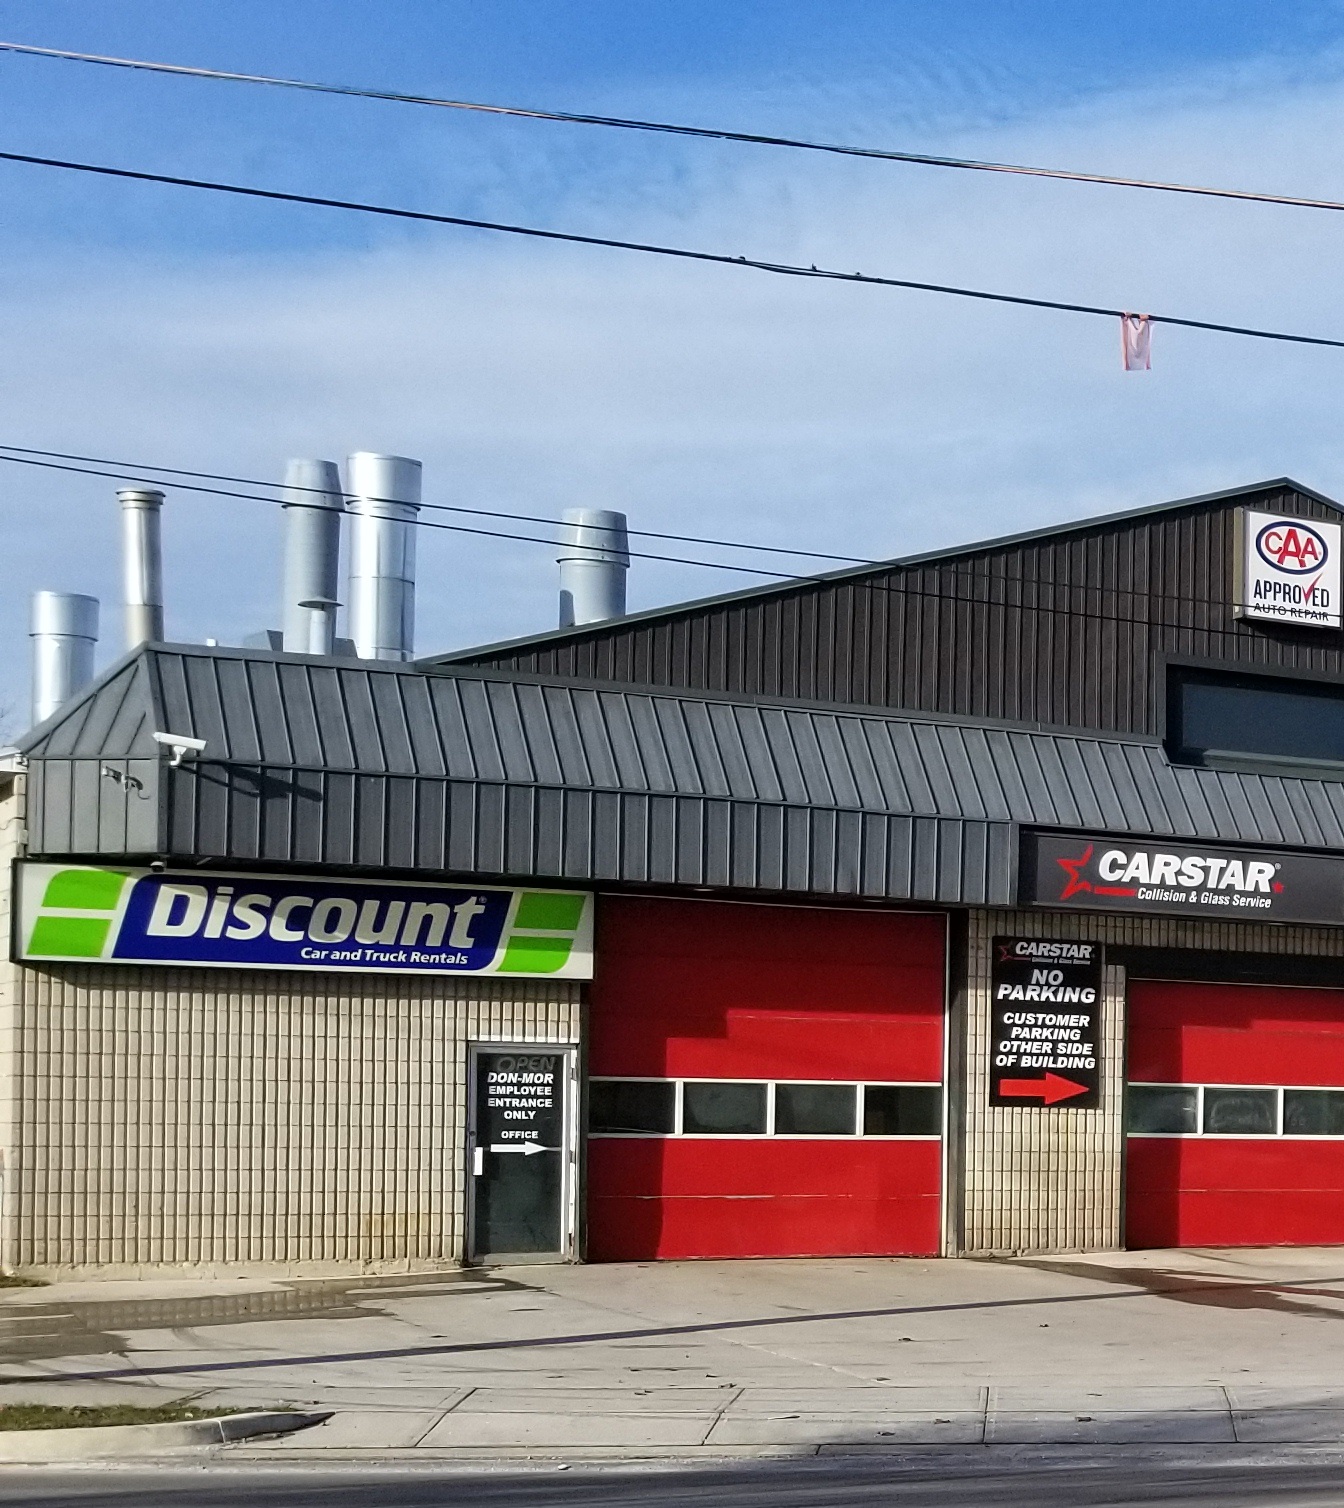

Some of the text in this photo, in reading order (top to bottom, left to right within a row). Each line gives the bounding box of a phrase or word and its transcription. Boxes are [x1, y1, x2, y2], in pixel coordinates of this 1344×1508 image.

[1264, 528, 1320, 568] CAA
[1253, 573, 1330, 608] APPROVED
[1253, 602, 1330, 622] AUTO REPAIR
[1098, 849, 1275, 893] CARSTAR
[1137, 887, 1272, 909] Collision & Glass Service
[146, 883, 485, 949] Discount
[301, 947, 468, 966] Car and Truck Rentals
[1015, 941, 1092, 959] CARSTAR
[1031, 968, 1064, 985] NO
[997, 983, 1096, 1004] PARKING
[1003, 1012, 1090, 1027] CUSTOMER
[1011, 1027, 1082, 1041] PARKING
[1000, 1040, 1094, 1055] OTHER SIDE
[497, 1056, 556, 1073] OPEN
[995, 1054, 1096, 1069] OF BUILDING
[487, 1071, 554, 1084] DON-MOR
[488, 1085, 553, 1096] EMPLOYEE
[487, 1097, 553, 1108] ENTRANCE
[503, 1110, 537, 1120] ONLY
[500, 1130, 539, 1139] OFFICE
